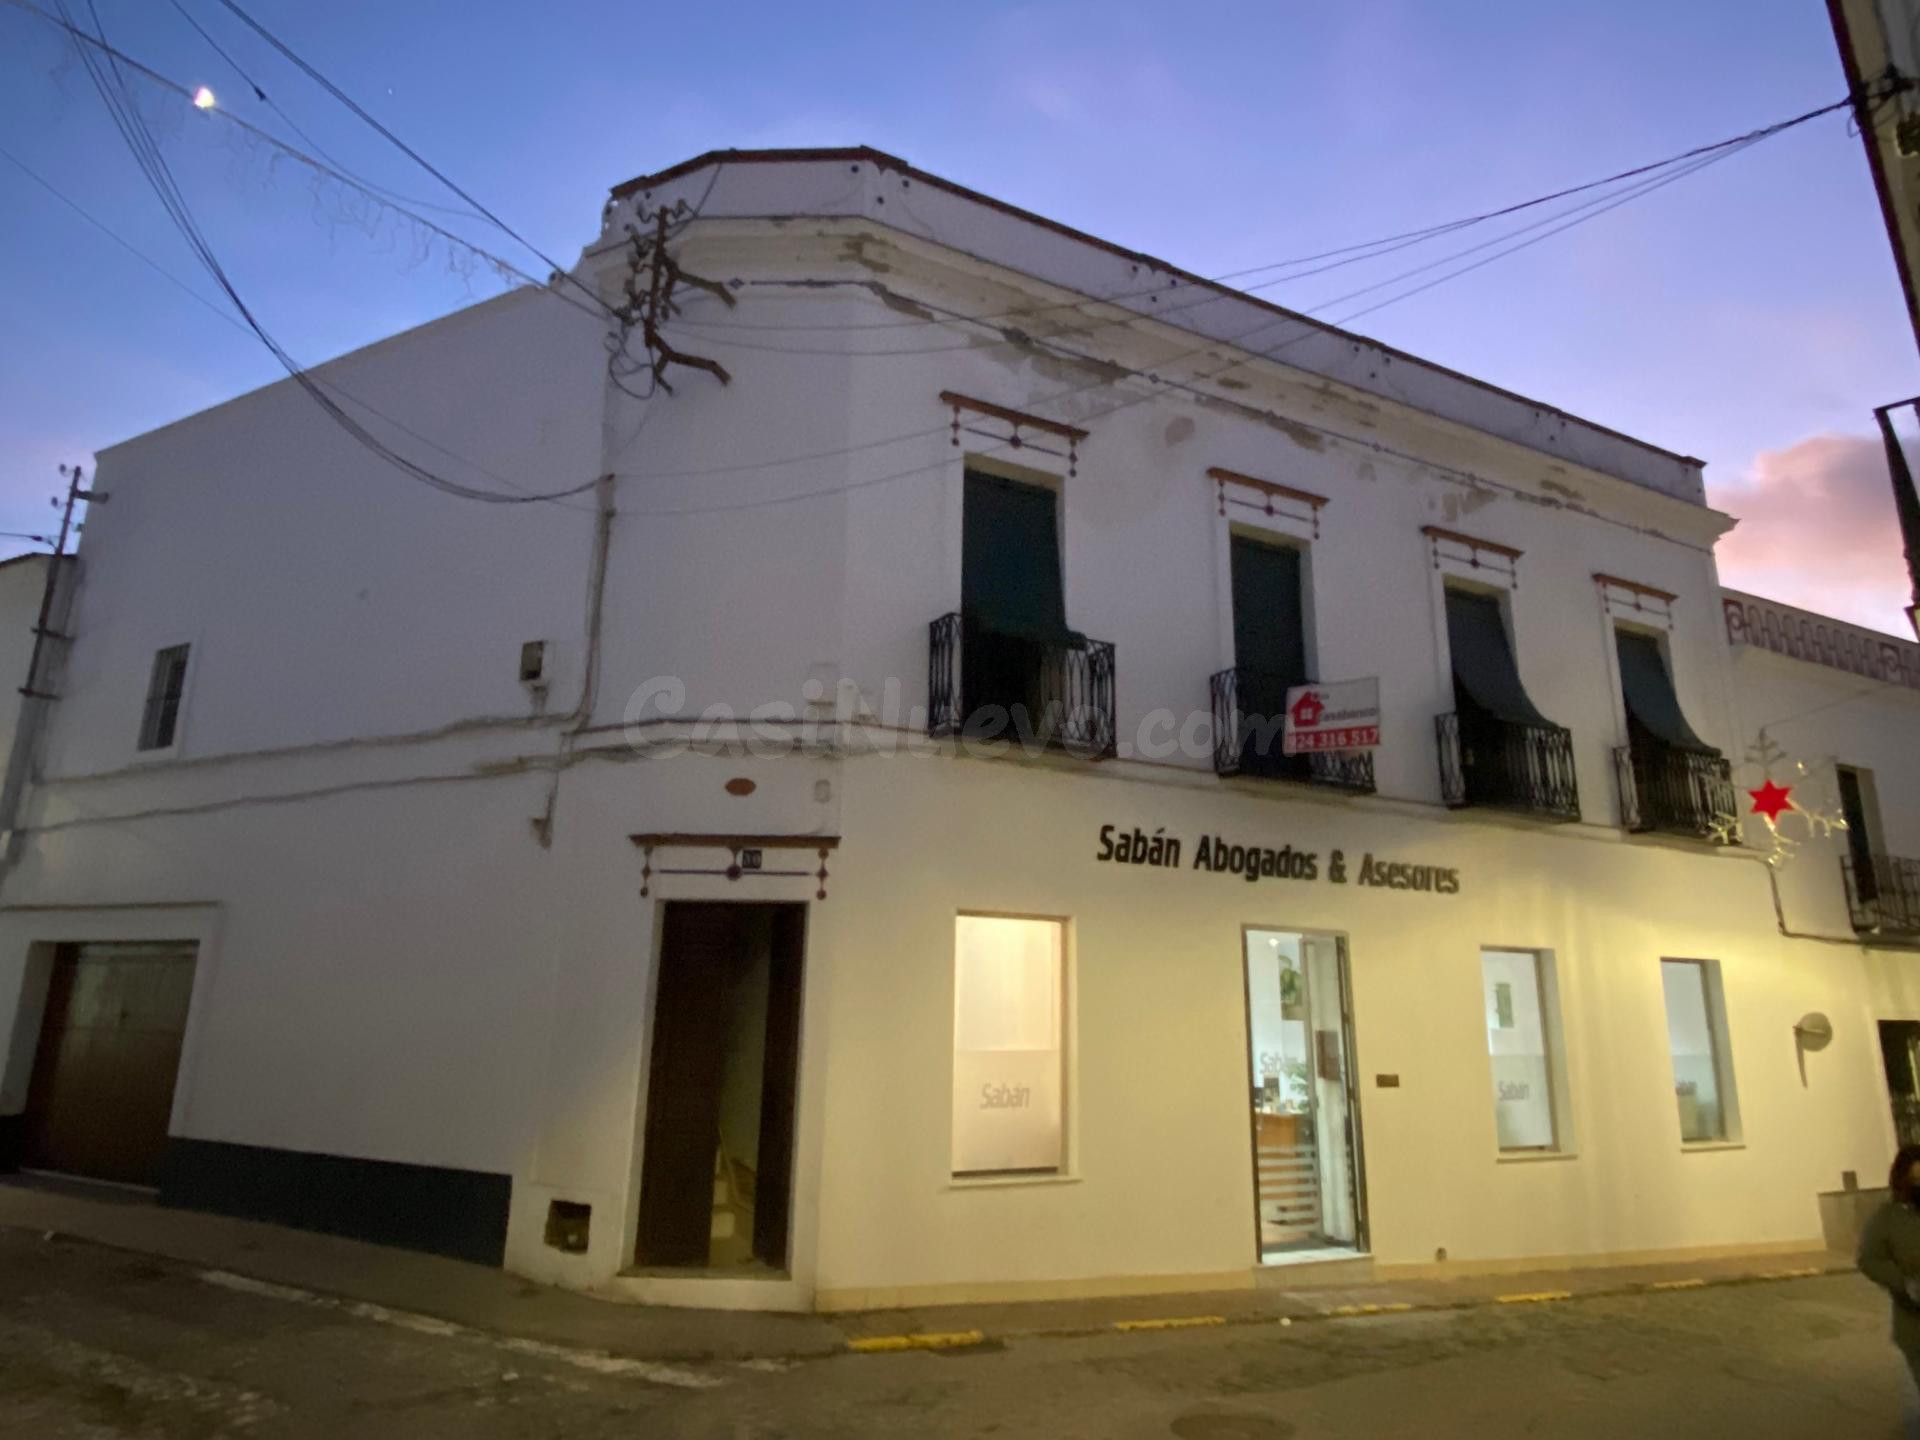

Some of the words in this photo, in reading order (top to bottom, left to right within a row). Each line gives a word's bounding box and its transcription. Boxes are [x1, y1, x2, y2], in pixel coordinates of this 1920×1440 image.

[1097, 824, 1181, 868] Sabán
[1193, 834, 1318, 882] Abogados
[1328, 849, 1347, 884] &
[1358, 852, 1460, 895] Asesores
[979, 1082, 1031, 1109] Sabán
